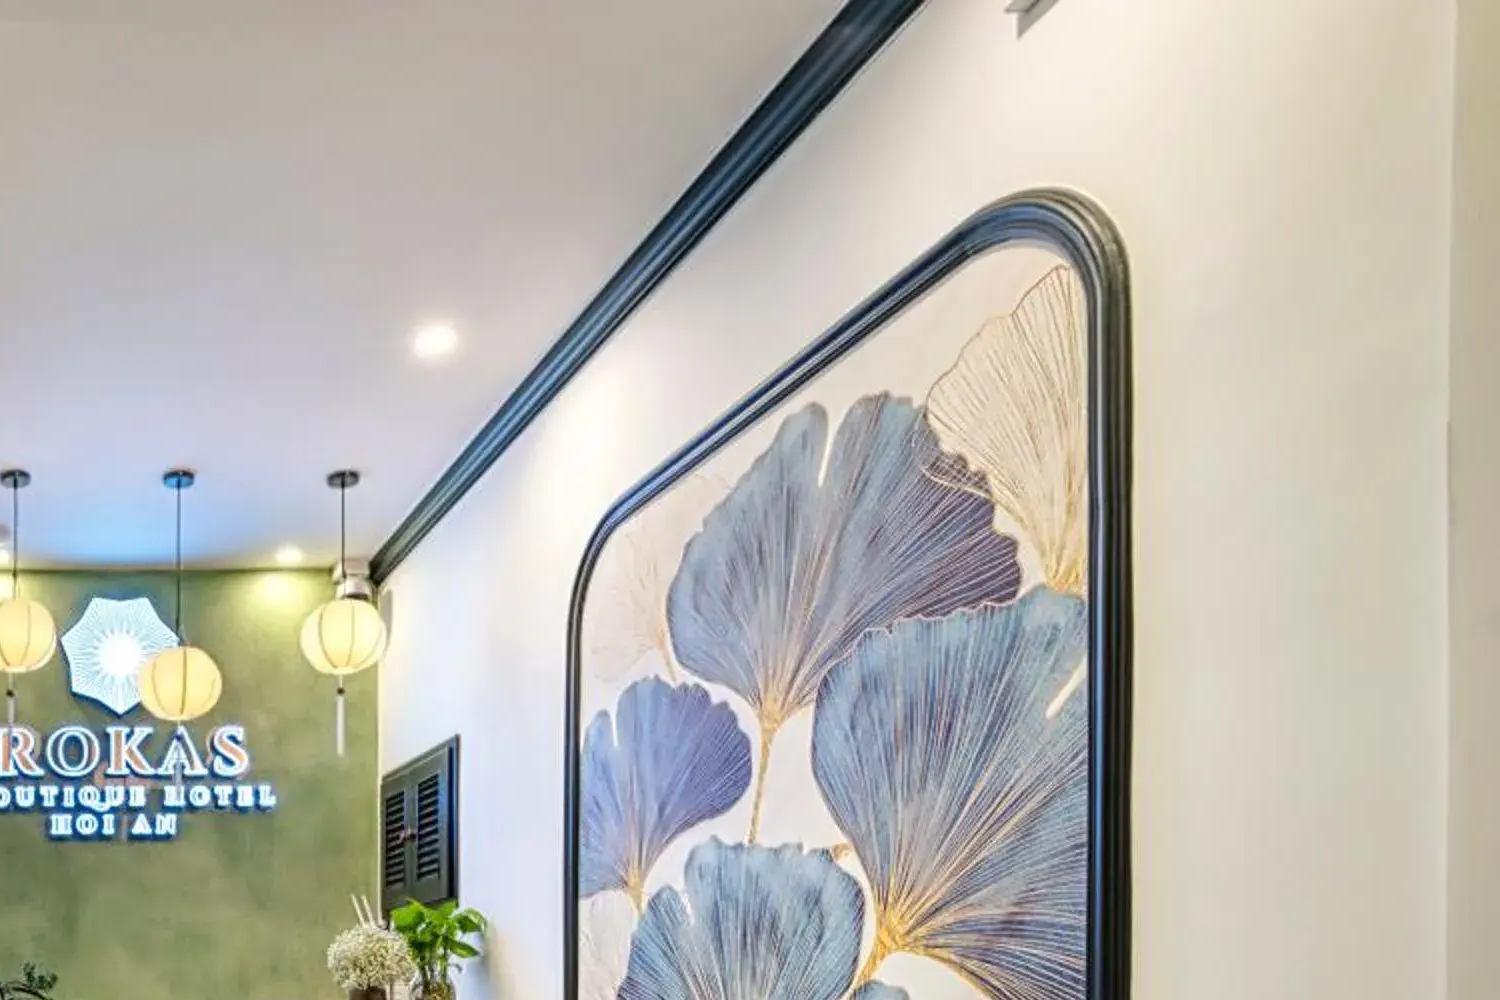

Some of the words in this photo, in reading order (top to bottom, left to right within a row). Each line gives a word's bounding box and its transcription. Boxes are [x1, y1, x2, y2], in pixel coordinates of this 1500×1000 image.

[164, 784, 278, 808] HOTEL
[49, 814, 115, 836] HOI
[131, 814, 177, 836] AN
